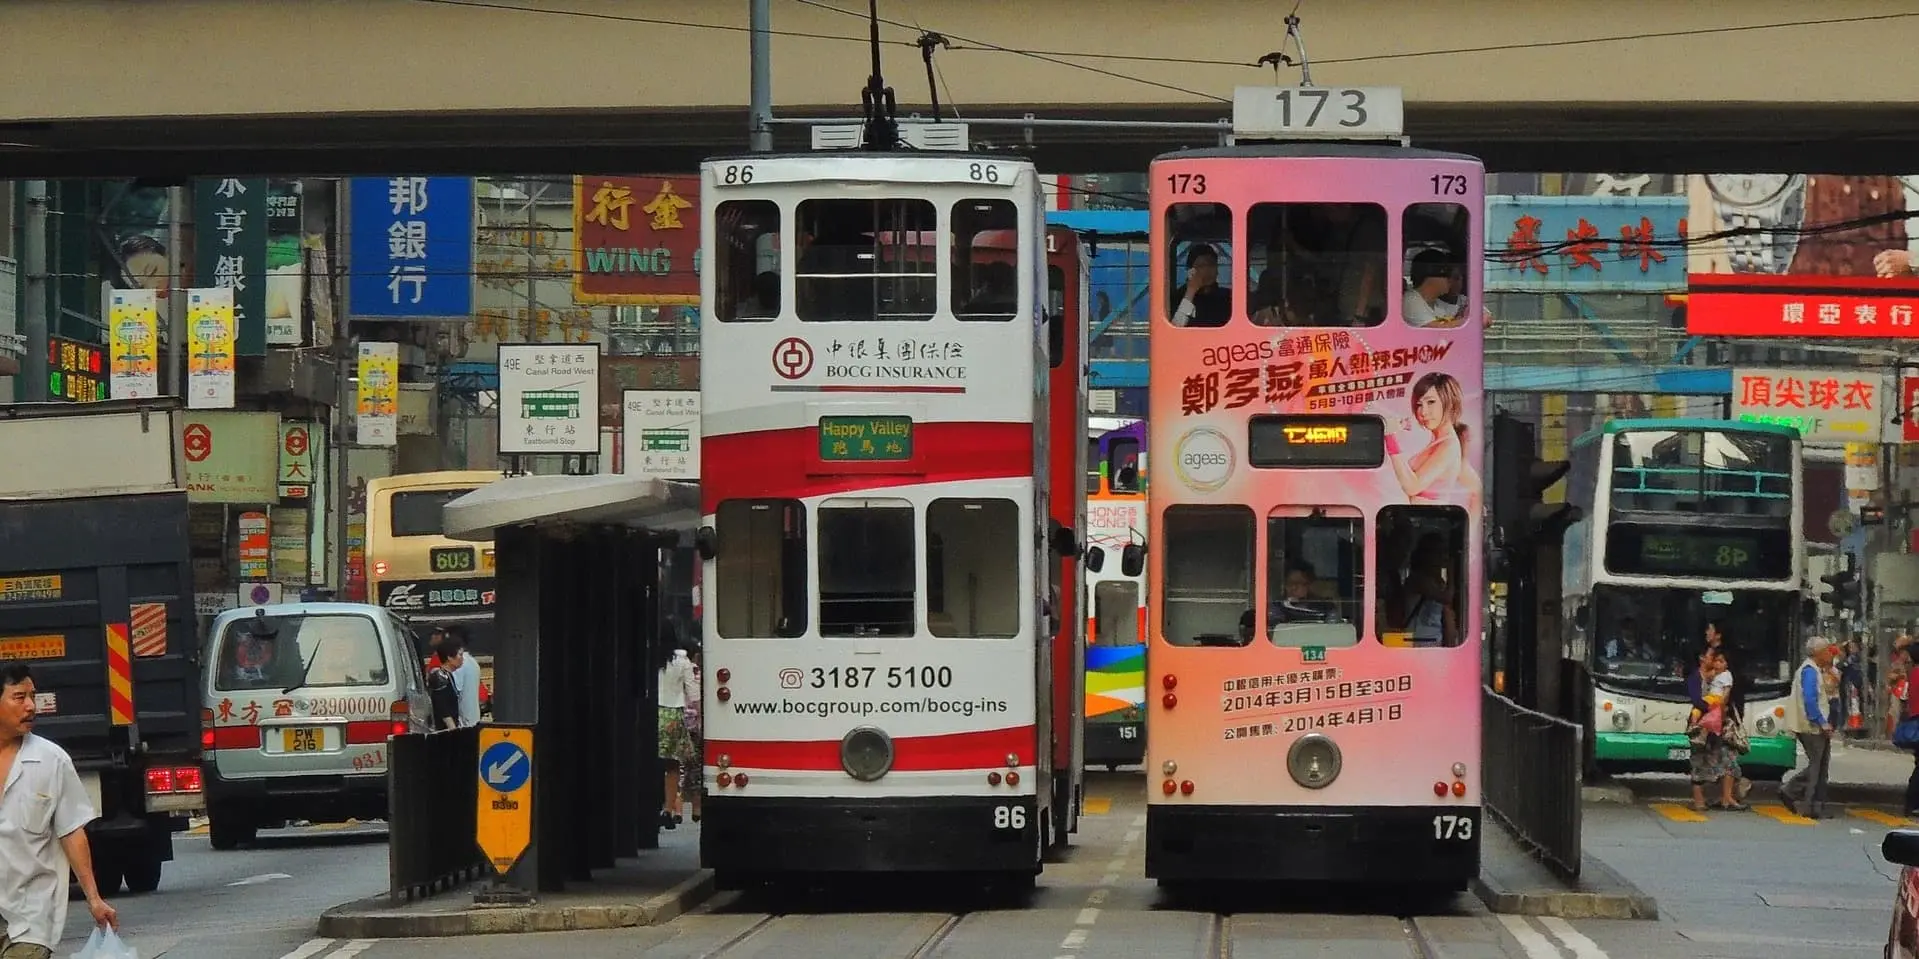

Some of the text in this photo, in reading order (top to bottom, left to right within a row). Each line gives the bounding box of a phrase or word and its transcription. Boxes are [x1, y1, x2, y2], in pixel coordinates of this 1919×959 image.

[1275, 89, 1368, 128] 173
[724, 165, 754, 185] 86
[969, 162, 999, 183] 86
[1167, 174, 1207, 195] 173
[1430, 175, 1468, 196] 173
[387, 176, 428, 304] 邦銀行
[585, 247, 671, 274] WING
[1782, 303, 1912, 326] 環亞表行
[826, 338, 965, 361] 中銀集團保險
[1202, 331, 1351, 371] ageas 富通保險
[503, 358, 521, 372] 49E
[525, 367, 595, 376] Canal Road West
[826, 365, 967, 380] BOCG INSURANCE
[1181, 361, 1304, 417] 鄭多燕
[1740, 375, 1875, 411] 頂尖球衣
[627, 400, 643, 412] 49E
[526, 424, 576, 436] 東行站
[823, 420, 911, 438] Happy Valley
[559, 437, 576, 446] Stop
[832, 440, 903, 455] 跑馬地
[1184, 451, 1226, 469] ageas
[435, 552, 470, 570] 603
[1715, 545, 1749, 568] 8P
[811, 665, 952, 689] 3187 5100
[1223, 675, 1412, 712] 2014年3月15日至30日
[217, 697, 263, 725] 東方
[310, 696, 386, 716] 23900000
[733, 697, 1008, 717] www.bocgroup.com/bocg-ins
[1284, 704, 1402, 733] 2014年4月1日
[294, 728, 313, 739] PW
[1119, 726, 1137, 739] 151
[293, 739, 316, 751] 216
[353, 751, 384, 771] 931
[491, 800, 519, 810] B390
[994, 805, 1026, 829] 86
[1432, 815, 1473, 841] 173
